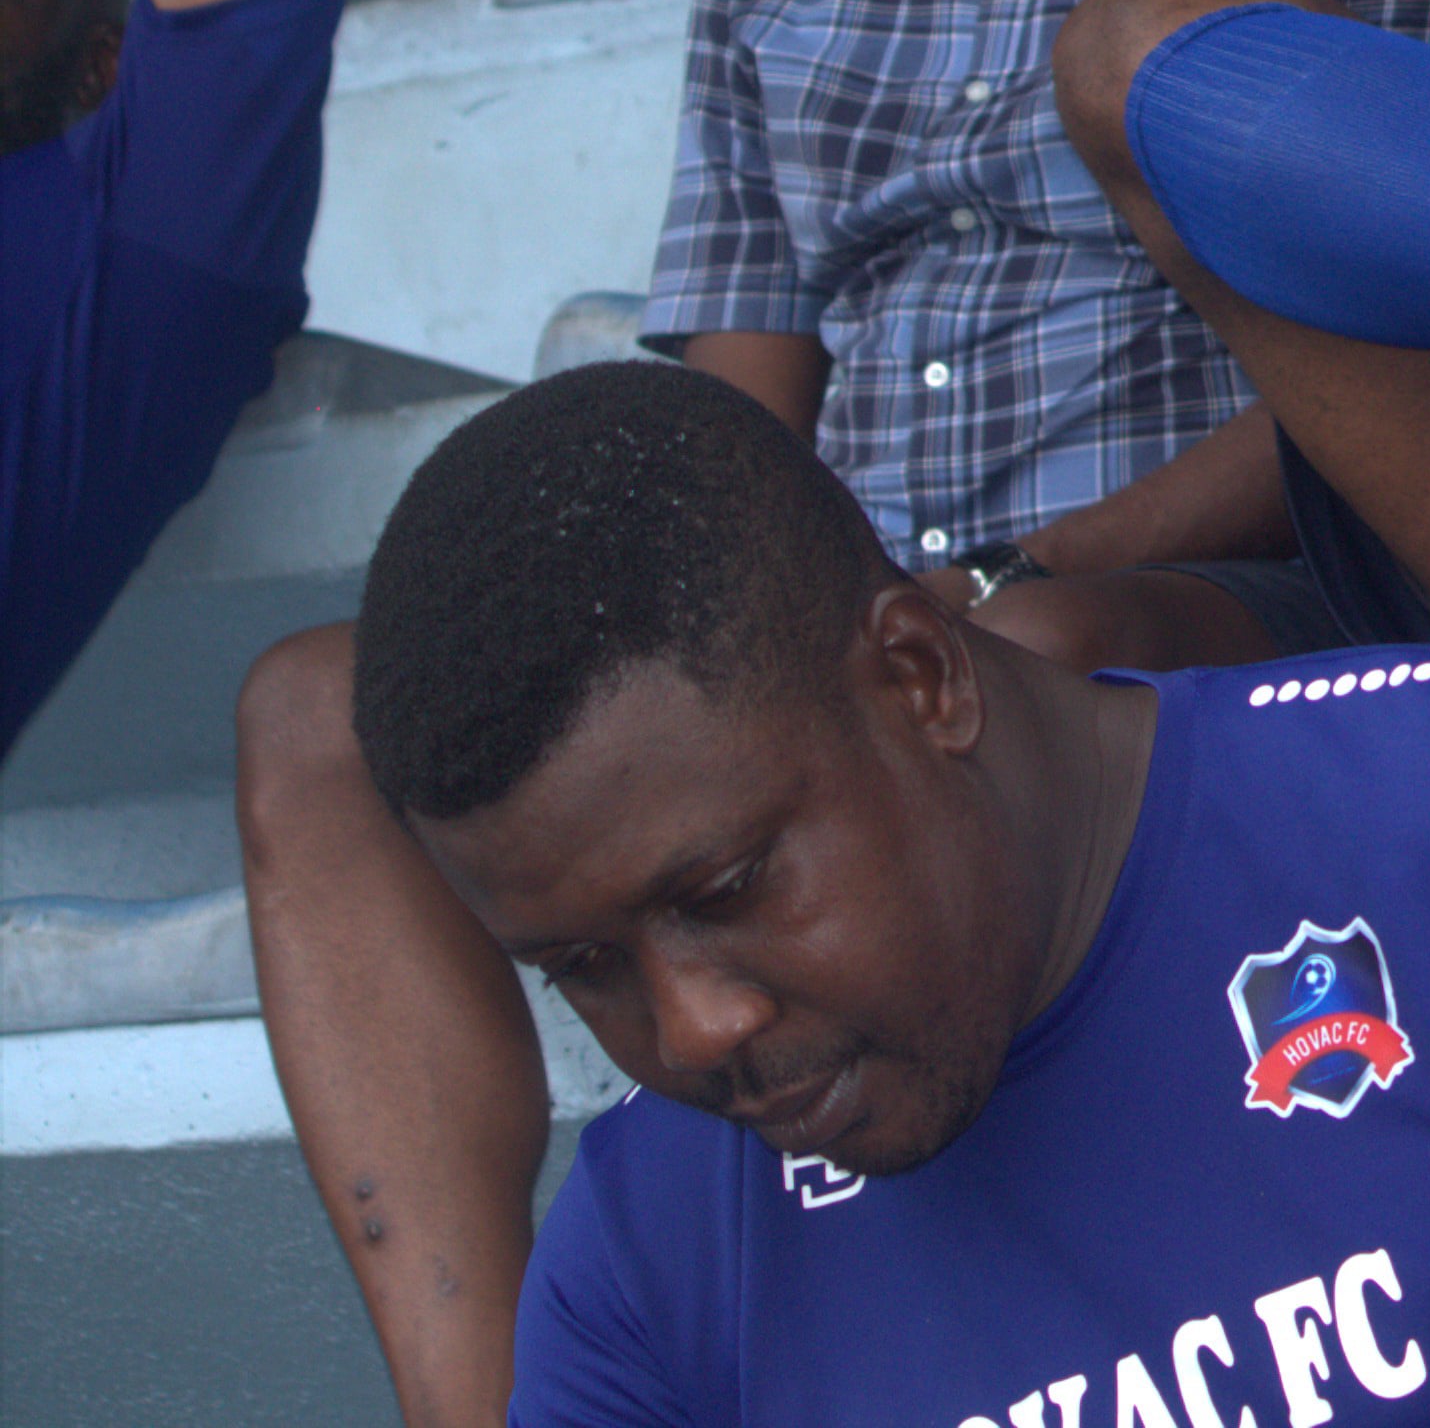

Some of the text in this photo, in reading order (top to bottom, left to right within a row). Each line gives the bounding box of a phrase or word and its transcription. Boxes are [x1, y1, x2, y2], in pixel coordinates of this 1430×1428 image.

[1283, 1021, 1371, 1066] HOVAC FC
[1255, 1248, 1428, 1428] FC
